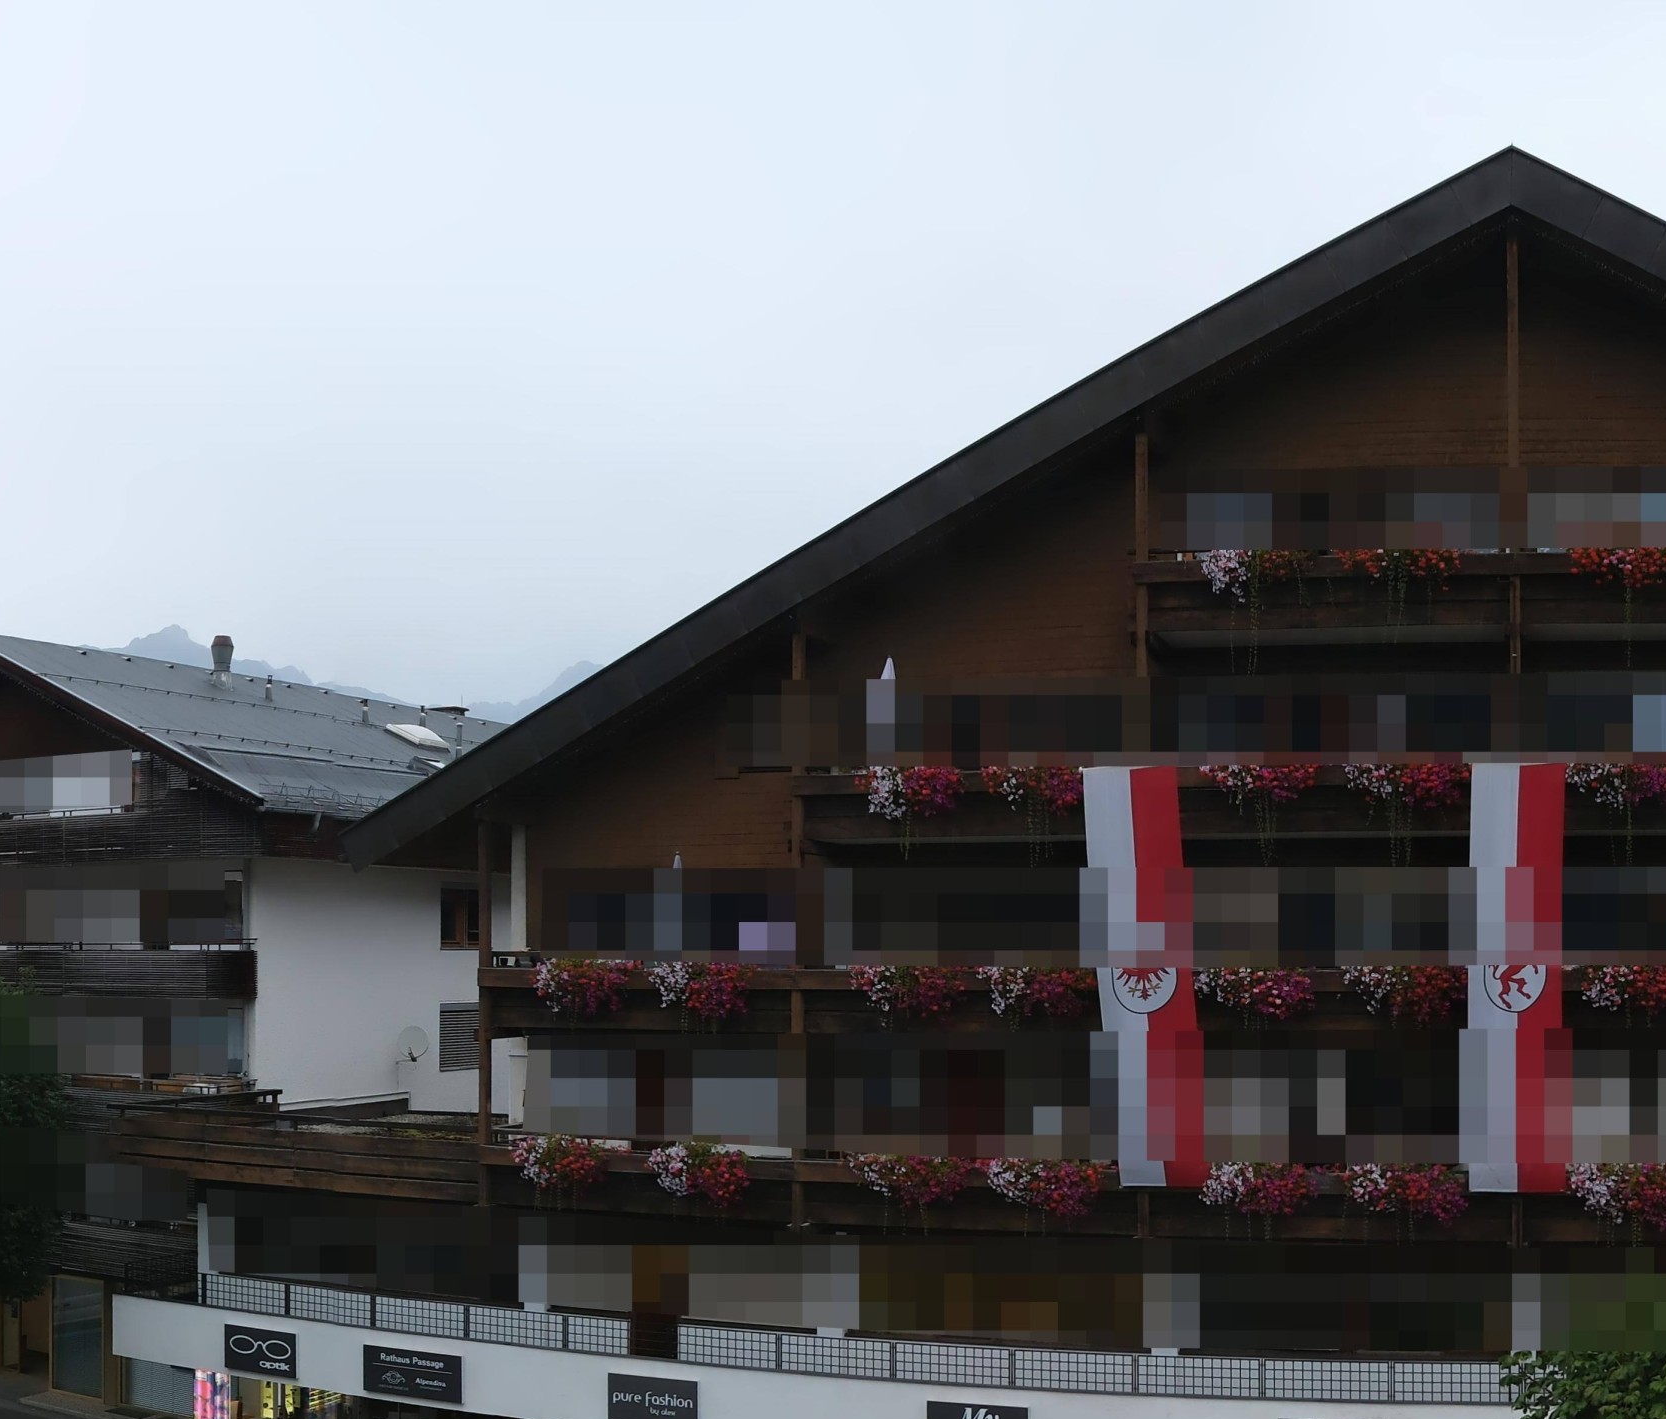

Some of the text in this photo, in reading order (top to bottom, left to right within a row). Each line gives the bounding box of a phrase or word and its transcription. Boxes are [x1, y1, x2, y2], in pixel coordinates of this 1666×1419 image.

[259, 1360, 290, 1372] optik
[380, 1353, 444, 1369] Rathaus Passage
[612, 1391, 693, 1408] pure fashion
[650, 1408, 676, 1417] by alex
